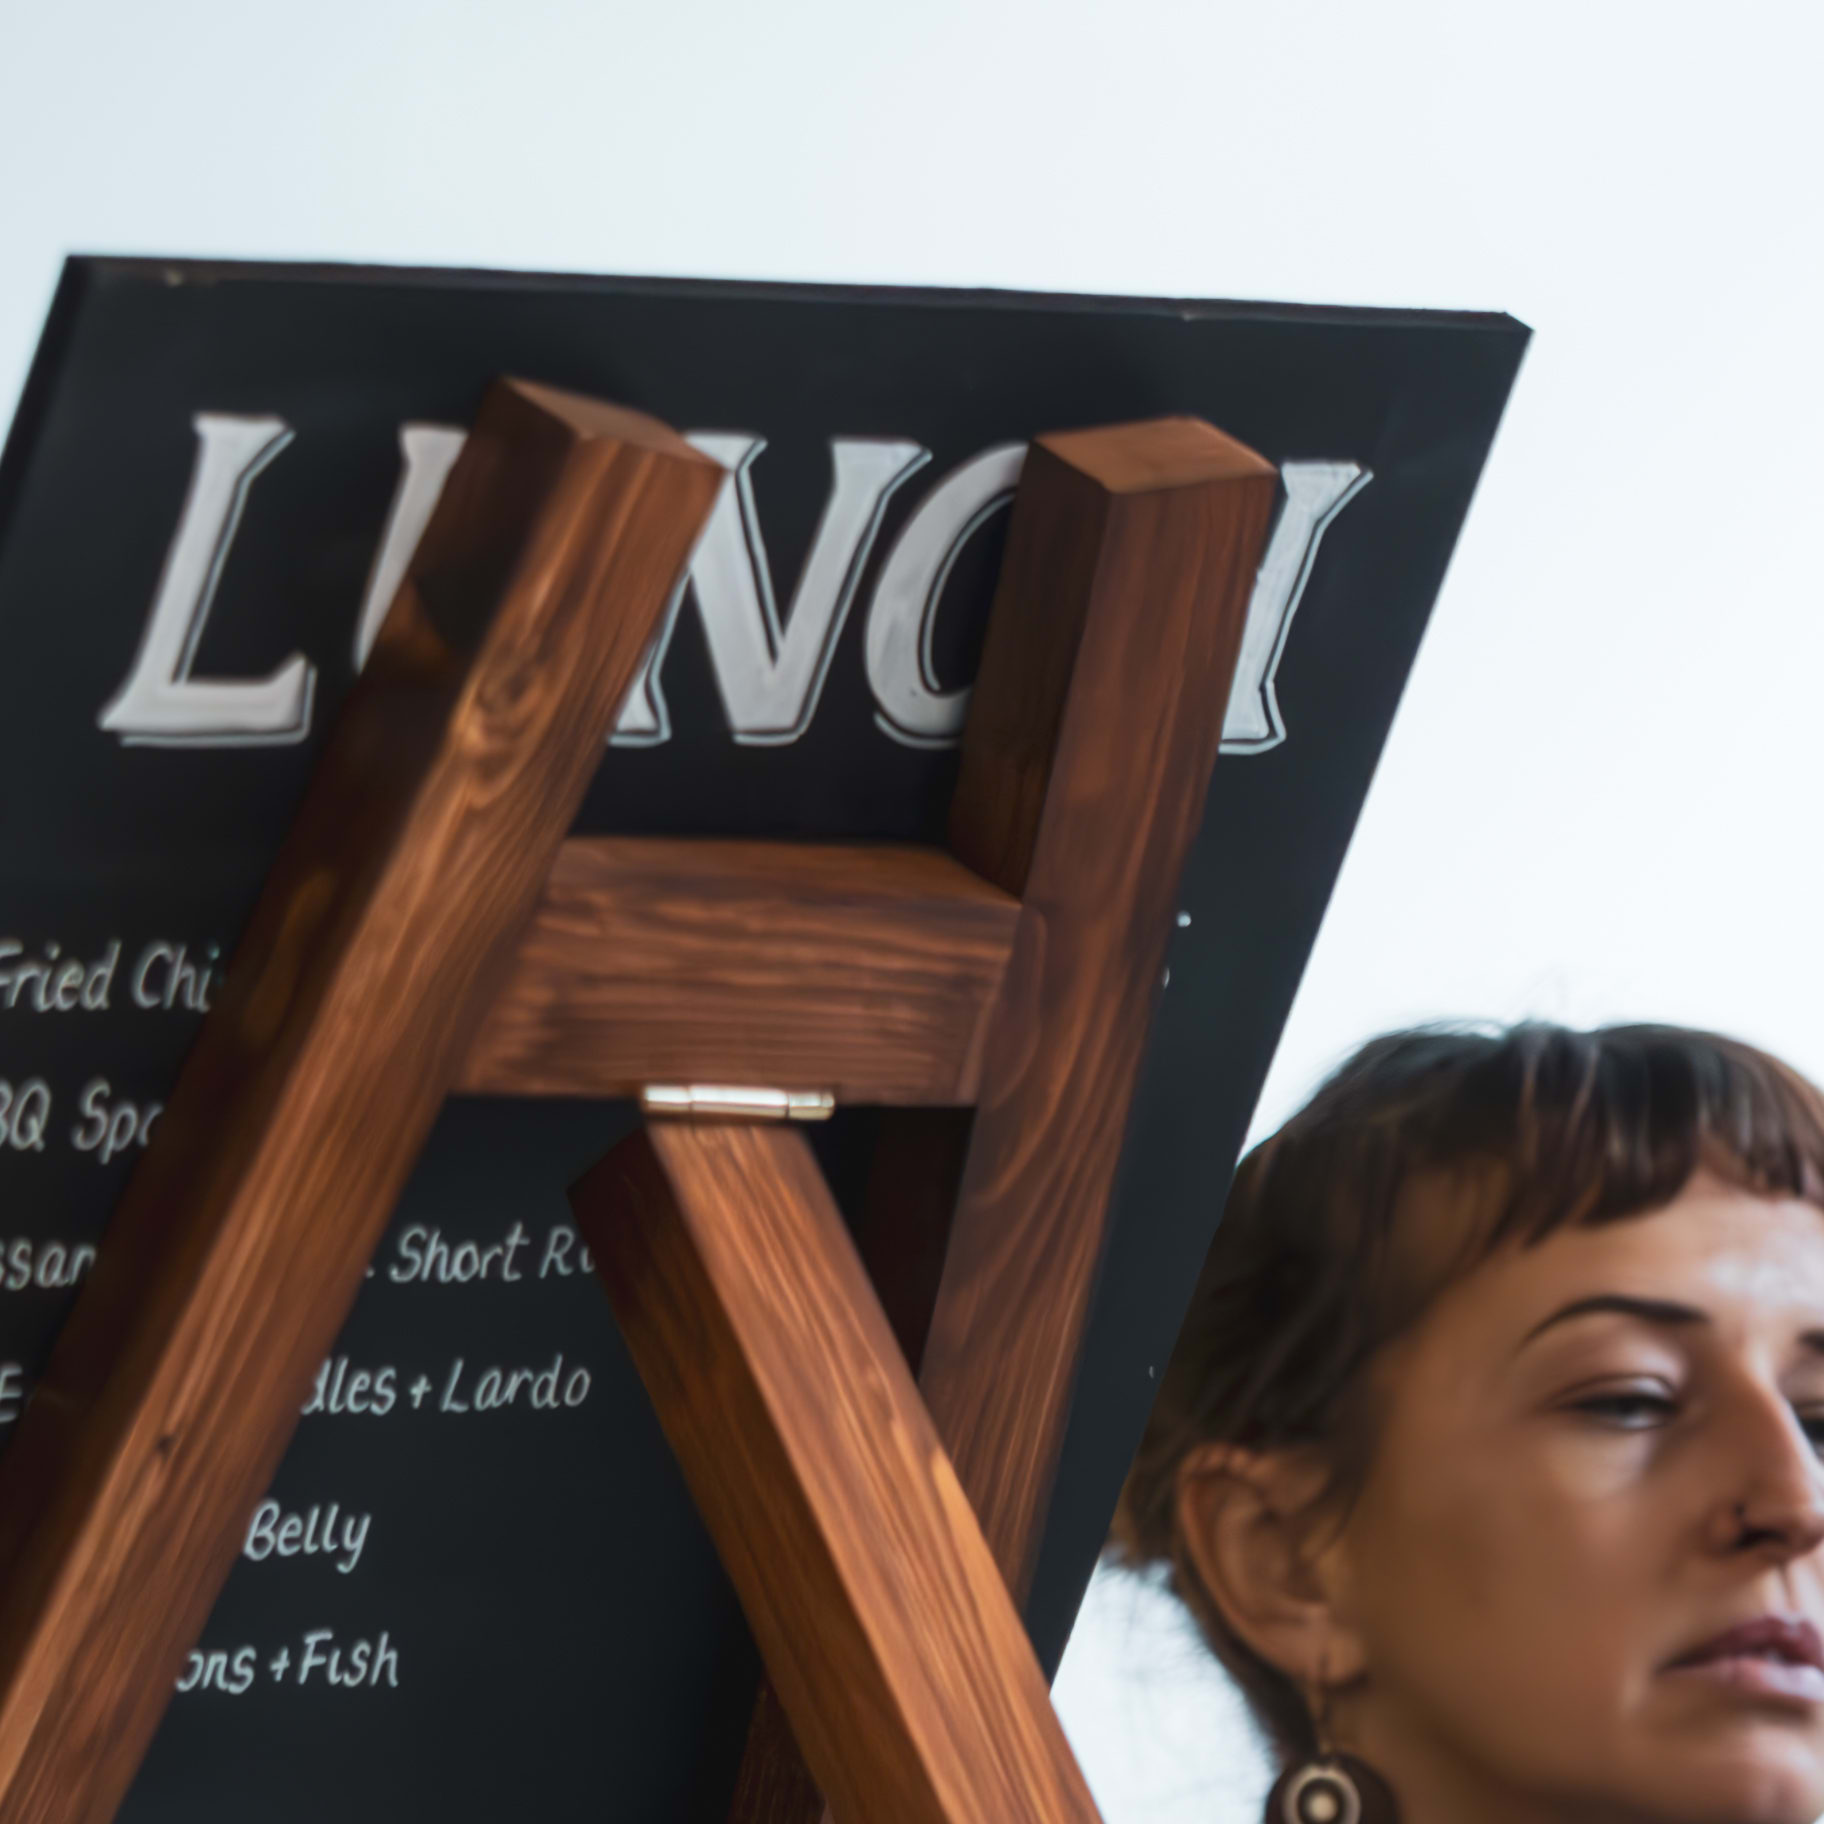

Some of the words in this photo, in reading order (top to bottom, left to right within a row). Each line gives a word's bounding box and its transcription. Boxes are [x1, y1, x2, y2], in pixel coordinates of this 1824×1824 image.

[132, 942, 220, 1012] Chi
[389, 1223, 529, 1283] Short
[440, 1354, 591, 1413] Lardo
[243, 1500, 371, 1574] Belly
[298, 1630, 398, 1687] Fish
